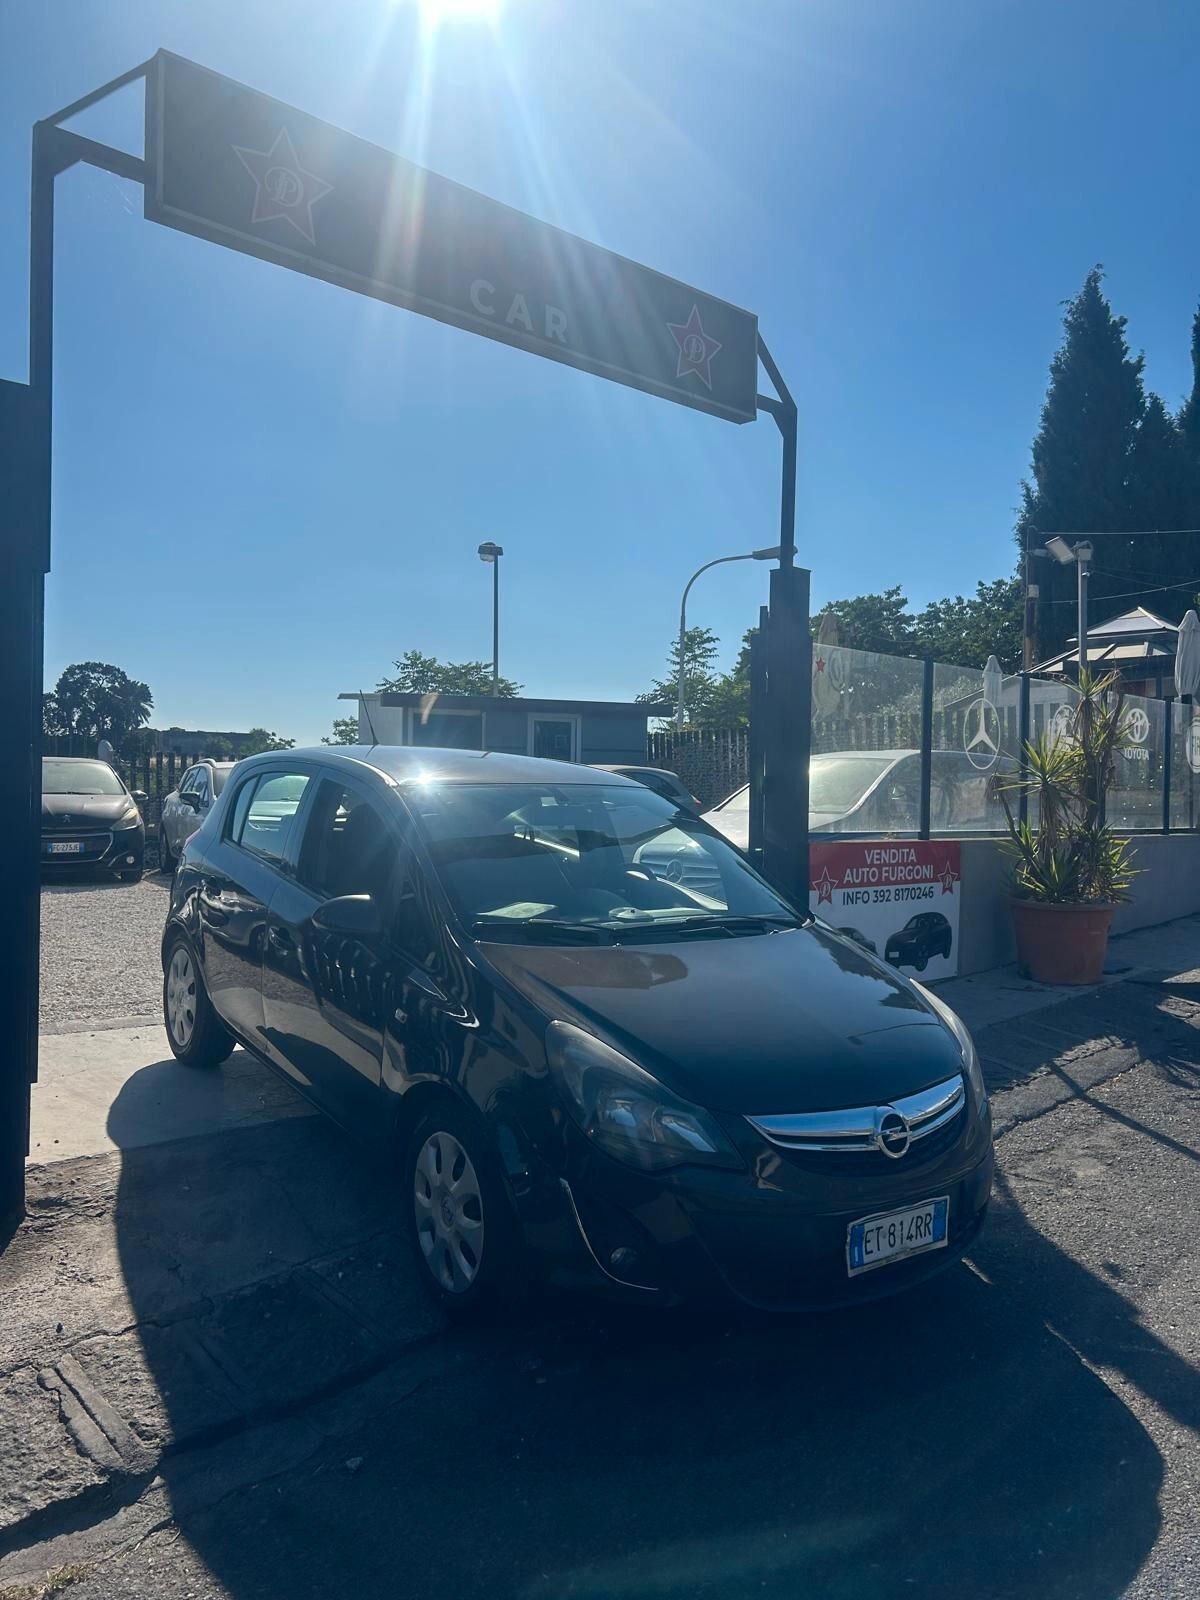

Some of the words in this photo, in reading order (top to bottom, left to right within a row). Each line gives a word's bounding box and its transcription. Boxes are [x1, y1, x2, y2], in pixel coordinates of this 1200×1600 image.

[470, 279, 568, 343] CAR
[1124, 747, 1150, 761] TOYOTA
[865, 848, 917, 865] VENDITA
[843, 867, 879, 884] AUTO
[882, 865, 934, 881] FURGONI
[842, 890, 870, 906] INFO
[872, 888, 891, 903] 392
[894, 886, 934, 901] 8170246
